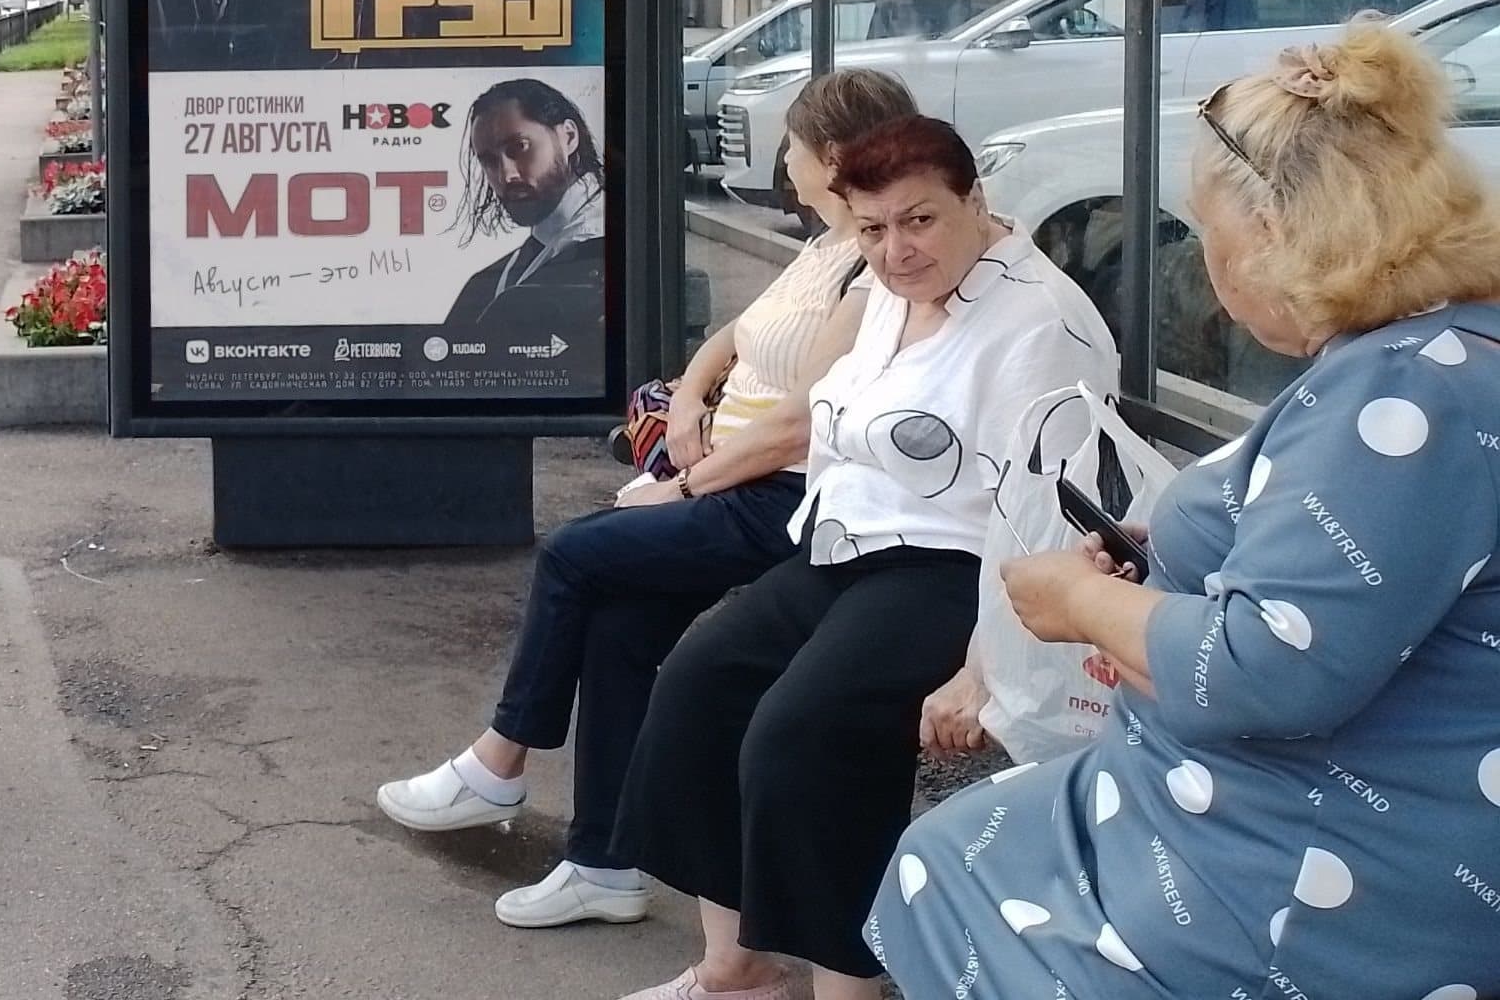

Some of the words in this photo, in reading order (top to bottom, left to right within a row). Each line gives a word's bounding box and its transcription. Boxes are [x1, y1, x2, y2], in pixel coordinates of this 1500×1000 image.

[184, 97, 224, 117] ДВОР
[228, 96, 304, 115] ГОСТИНКИ
[184, 124, 216, 154] 27
[221, 121, 332, 153] АВГУСТА
[372, 136, 422, 147] РАДИО
[185, 171, 448, 239] МОТ
[193, 266, 281, 308] Август
[319, 265, 359, 283] это
[368, 247, 412, 275] МЫ
[452, 343, 486, 355] KUDAGO
